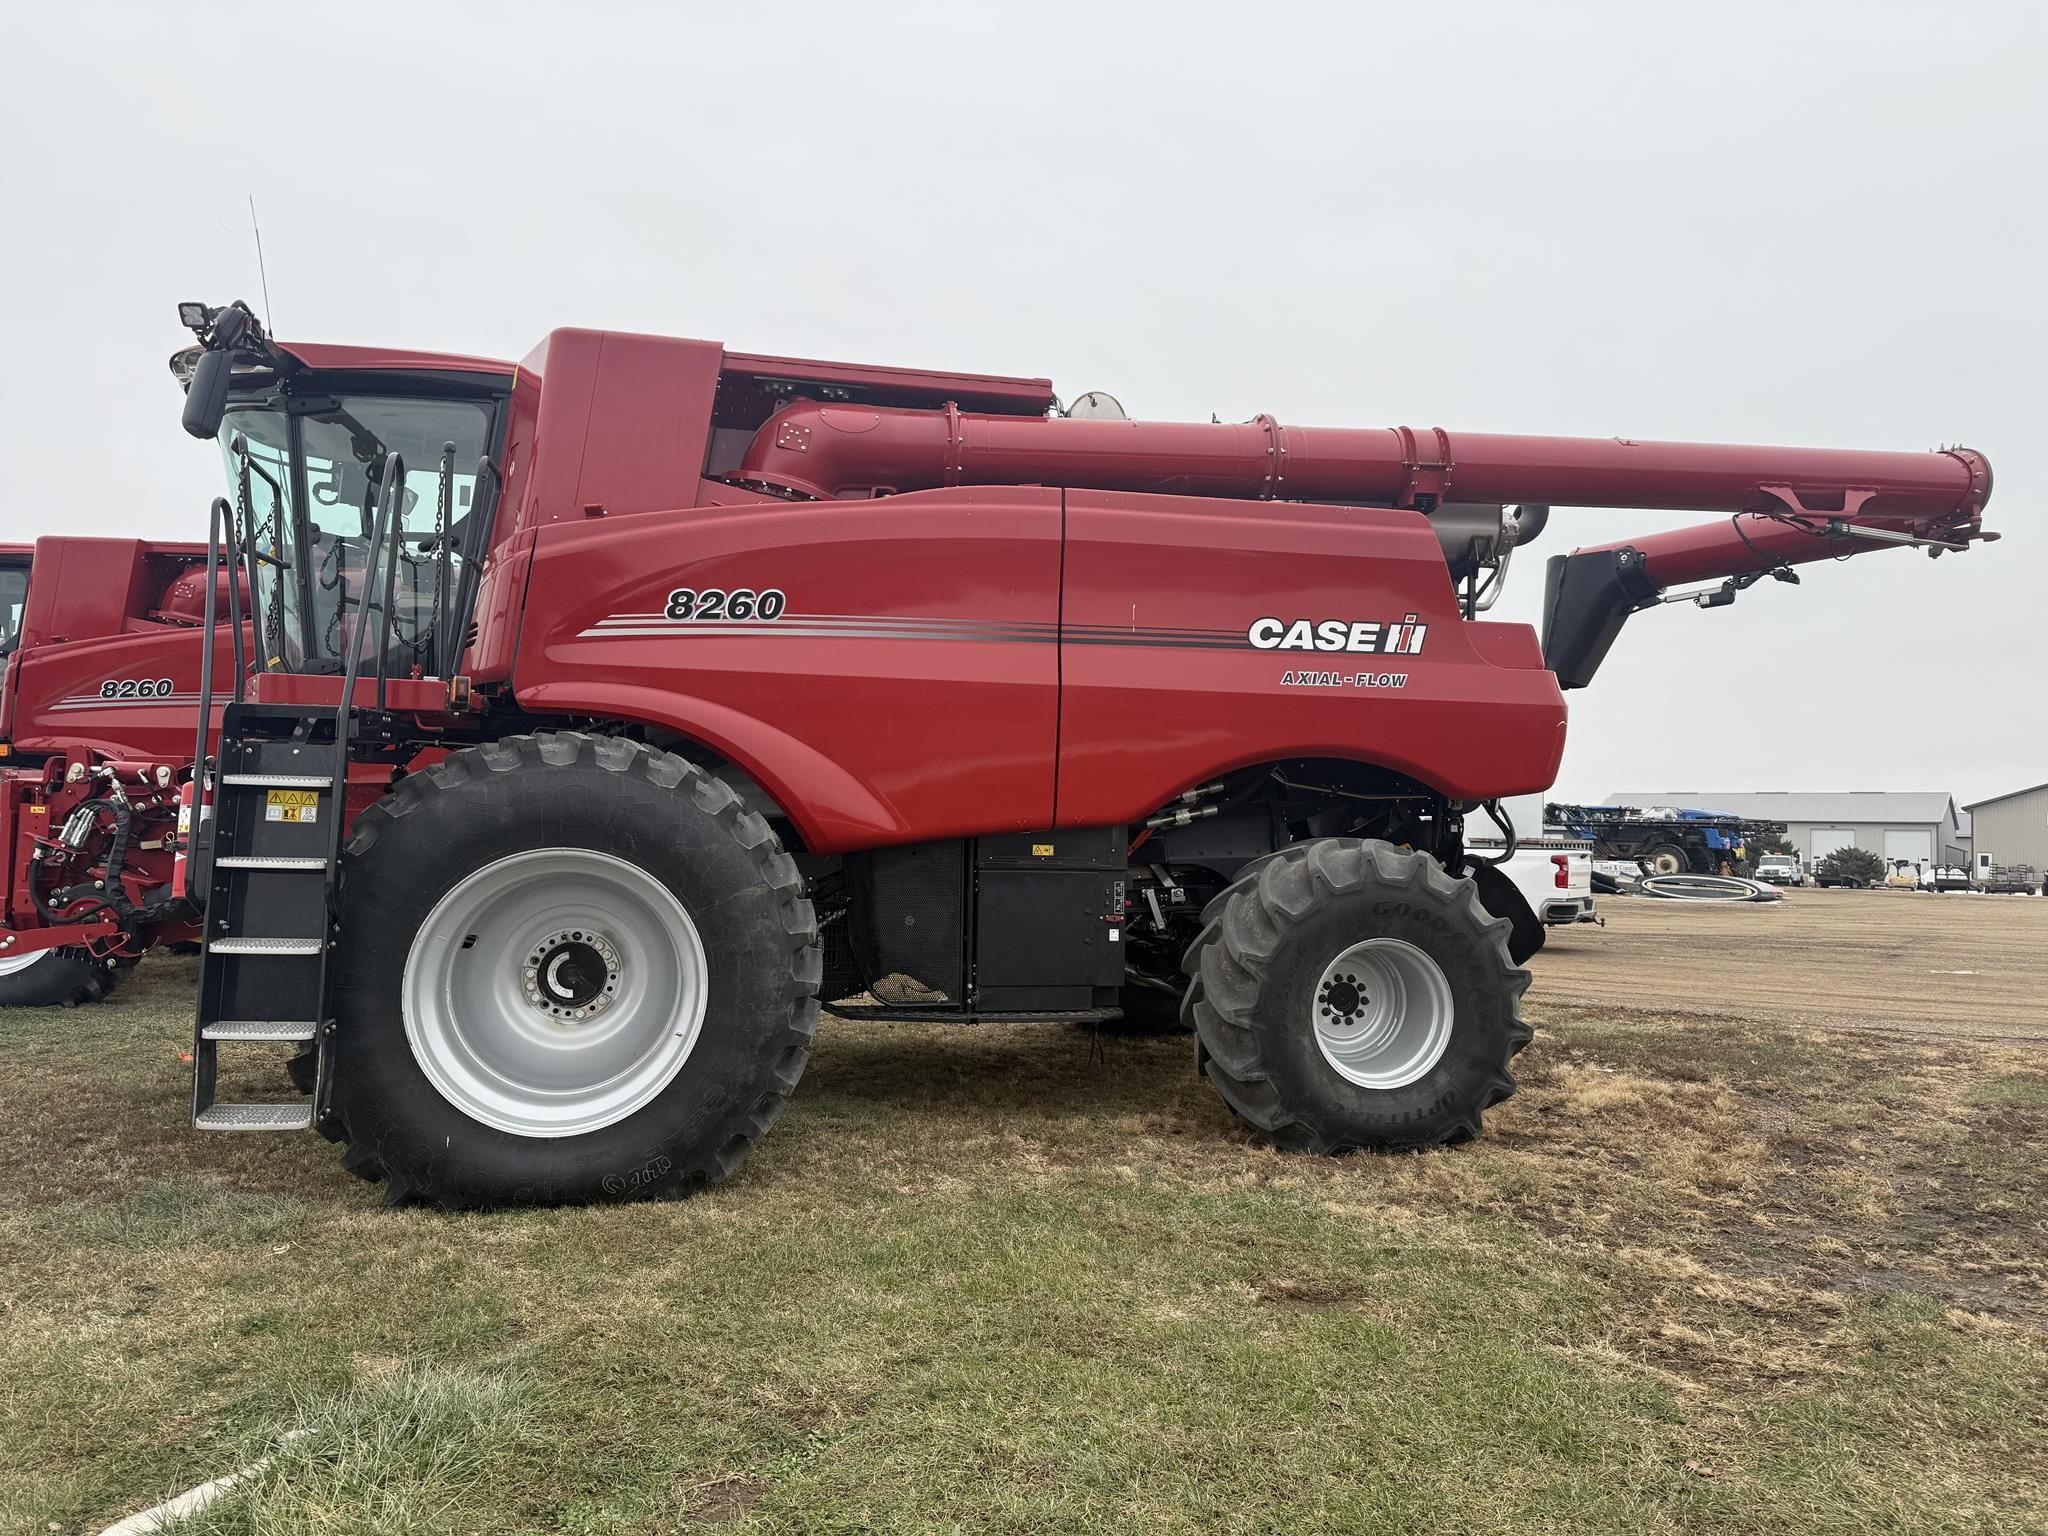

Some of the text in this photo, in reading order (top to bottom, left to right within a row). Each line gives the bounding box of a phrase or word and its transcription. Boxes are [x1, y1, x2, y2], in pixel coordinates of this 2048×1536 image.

[664, 588, 786, 621] 8260
[1249, 616, 1382, 652] CASE
[100, 678, 174, 699] 8260
[1280, 671, 1408, 687] AXIAL-FLOW
